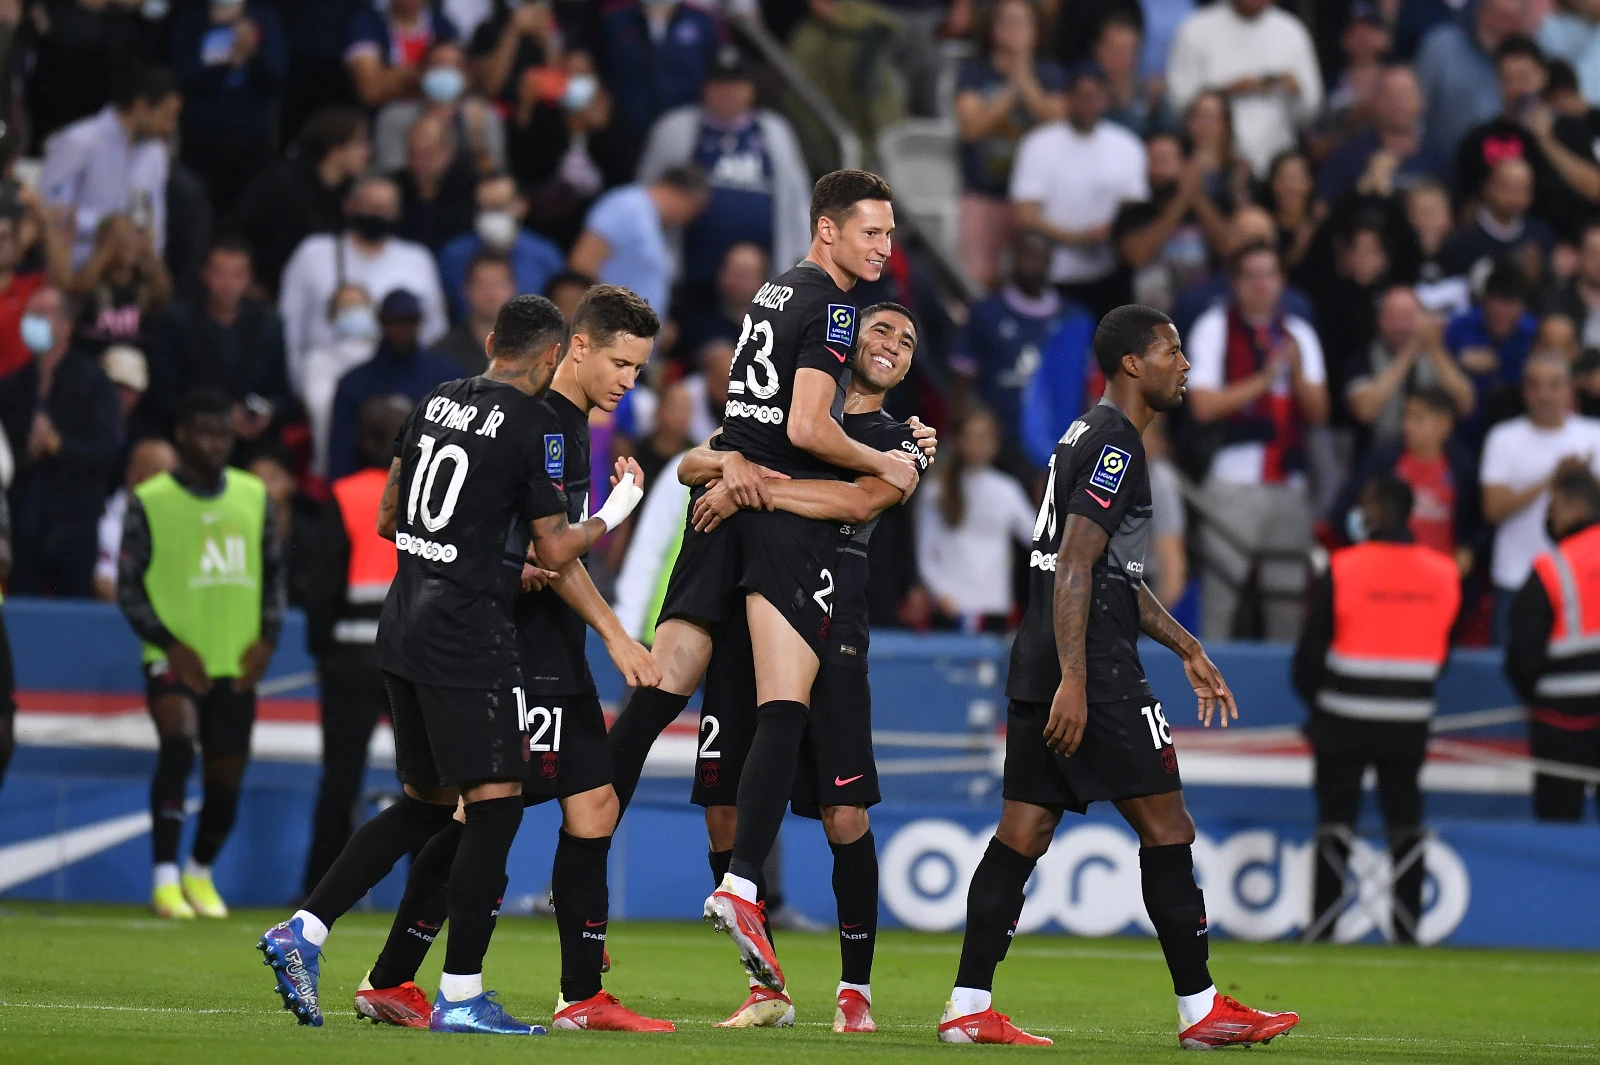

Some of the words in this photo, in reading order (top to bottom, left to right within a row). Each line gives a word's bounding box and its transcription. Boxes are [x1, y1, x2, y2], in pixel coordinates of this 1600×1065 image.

[728, 313, 780, 399] 23
[425, 396, 478, 432] NEYMAR
[408, 434, 469, 533] 10
[813, 568, 835, 619] 2
[512, 686, 530, 732] 1
[527, 706, 562, 752] 21
[1141, 702, 1173, 750] 18
[700, 715, 721, 758] 2
[841, 930, 868, 940] PARIS
